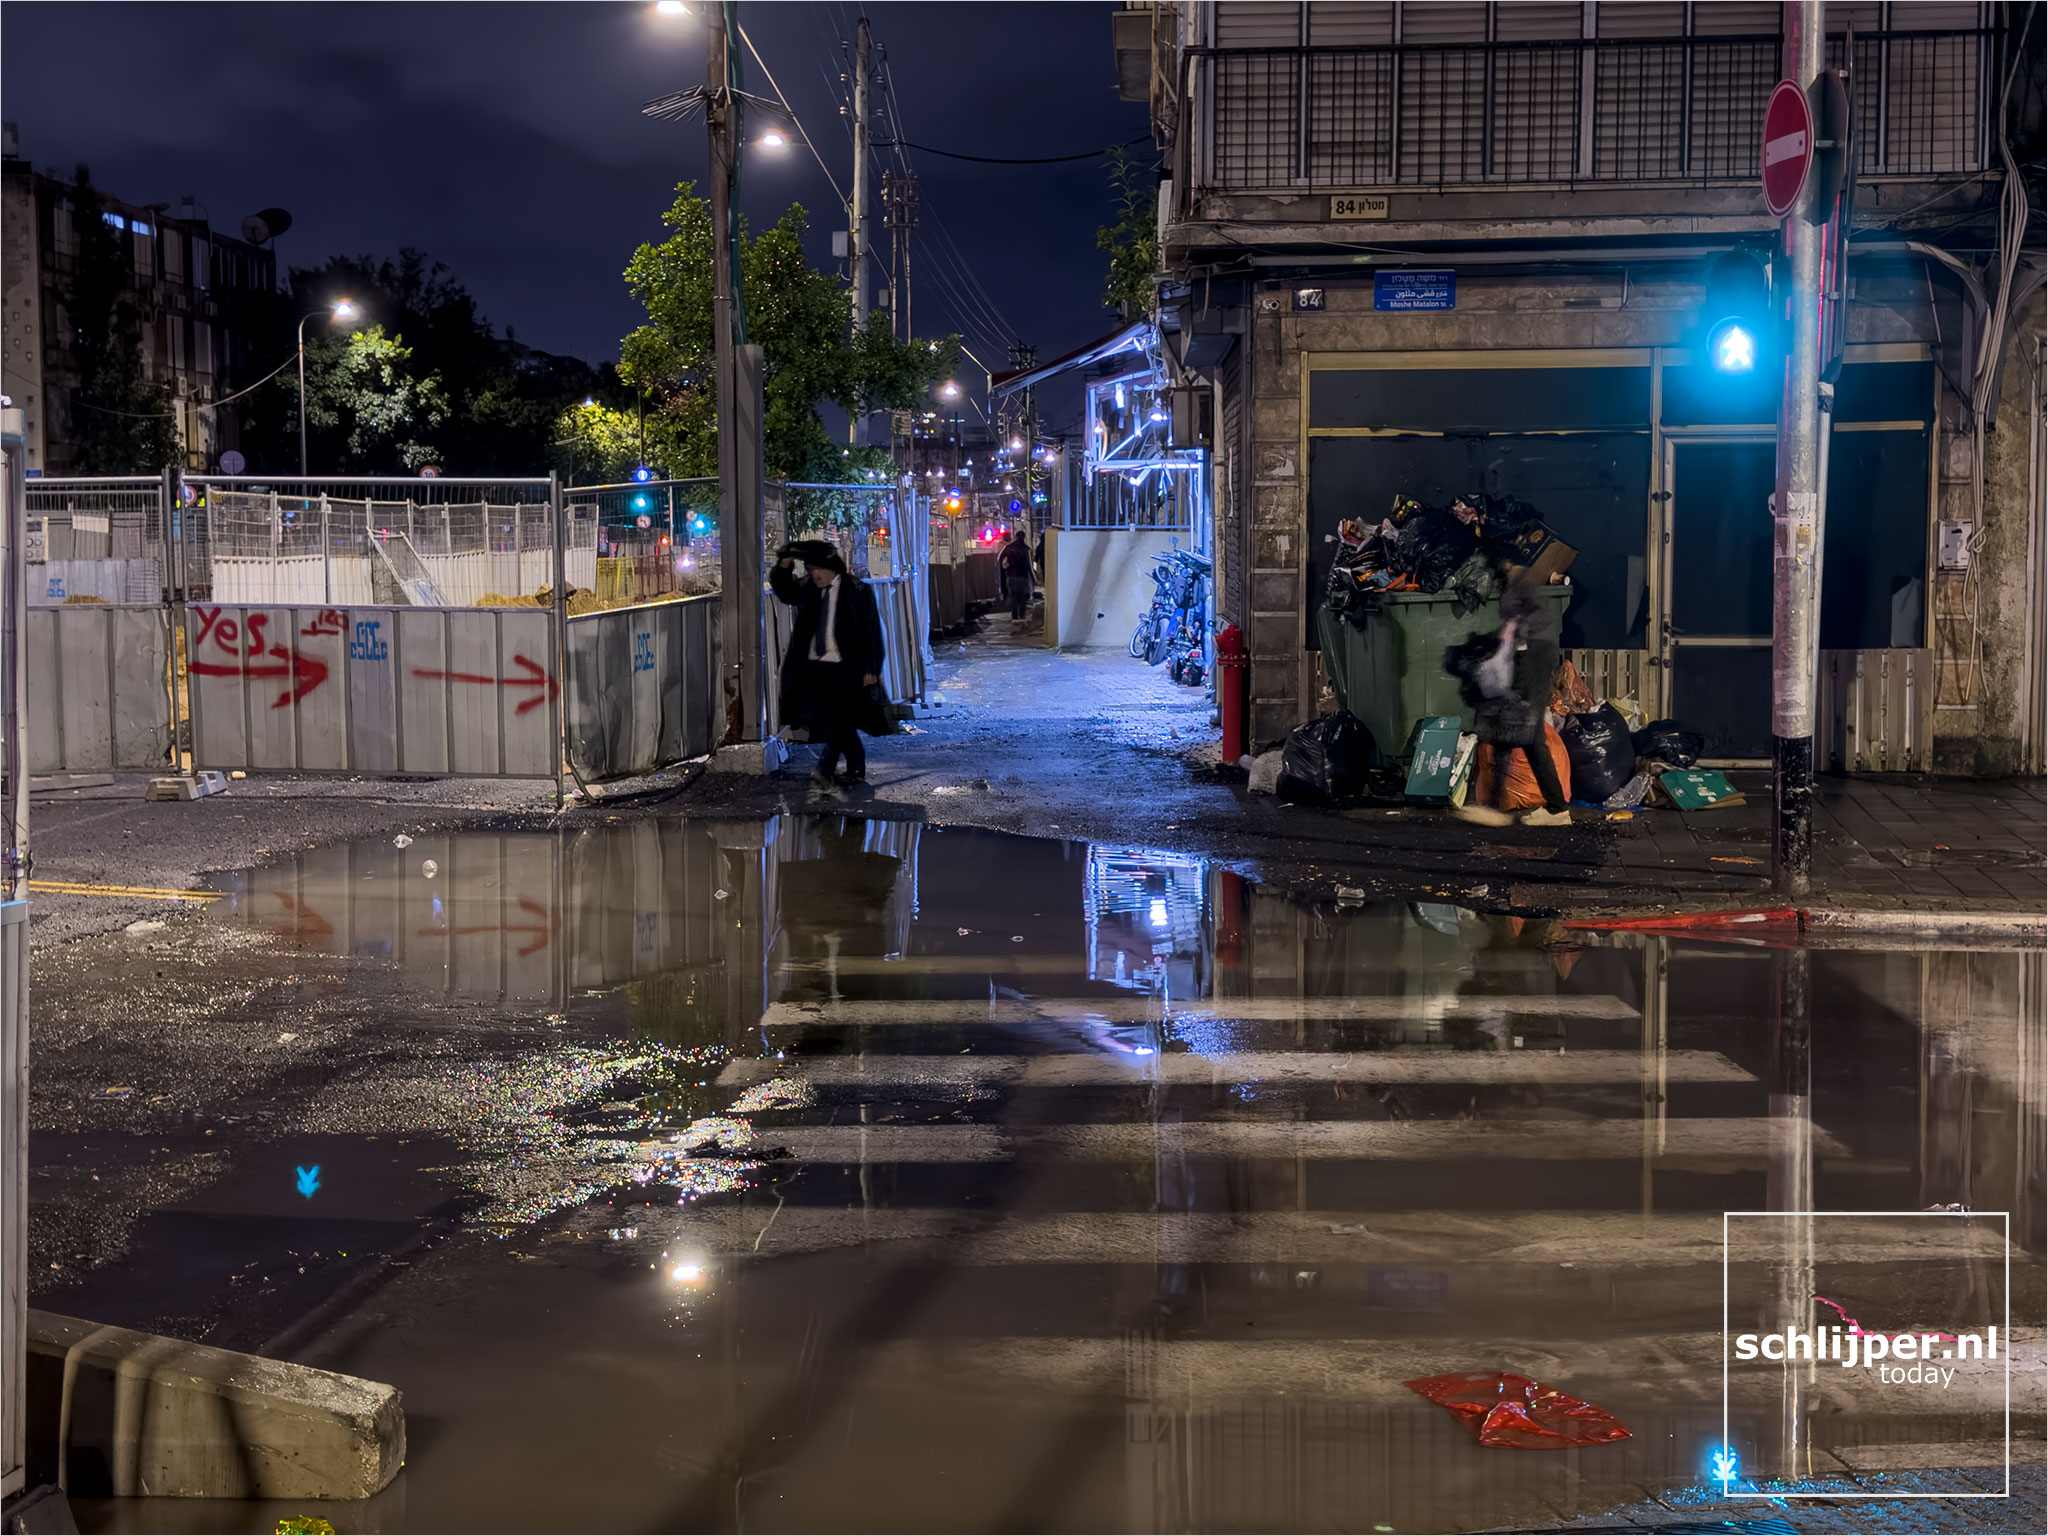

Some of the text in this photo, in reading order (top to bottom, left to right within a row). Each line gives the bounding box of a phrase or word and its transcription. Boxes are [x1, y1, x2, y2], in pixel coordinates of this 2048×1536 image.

[1336, 198, 1385, 214] מטלון 84
[194, 605, 268, 657] Yes
